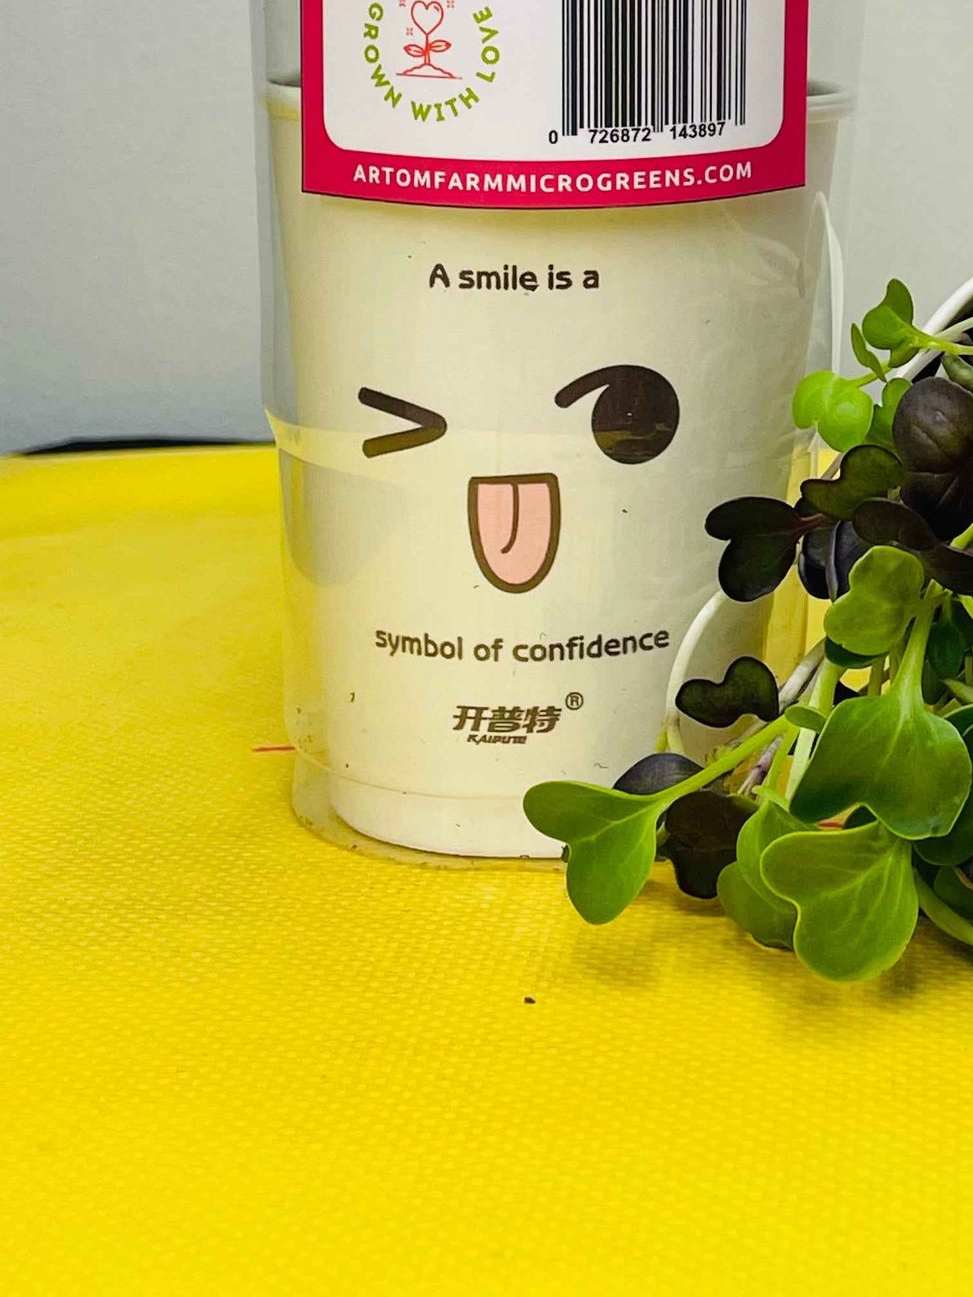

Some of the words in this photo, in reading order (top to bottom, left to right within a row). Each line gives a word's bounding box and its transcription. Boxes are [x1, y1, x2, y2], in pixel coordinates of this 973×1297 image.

[364, 2, 402, 108] GROWN
[411, 88, 479, 122] WITH
[473, 7, 500, 82] LOVE
[549, 130, 558, 144] 0
[589, 128, 651, 144] 726872
[670, 122, 726, 140] 143897
[353, 161, 753, 193] ARTOMFARMMICROGREENS.COM
[430, 264, 450, 288] A
[459, 264, 539, 291] smile
[548, 264, 572, 290] is
[583, 270, 599, 289] a
[376, 630, 462, 660] symbol
[474, 638, 503, 662] of
[513, 630, 669, 662] confidence
[453, 705, 562, 734] 开普特
